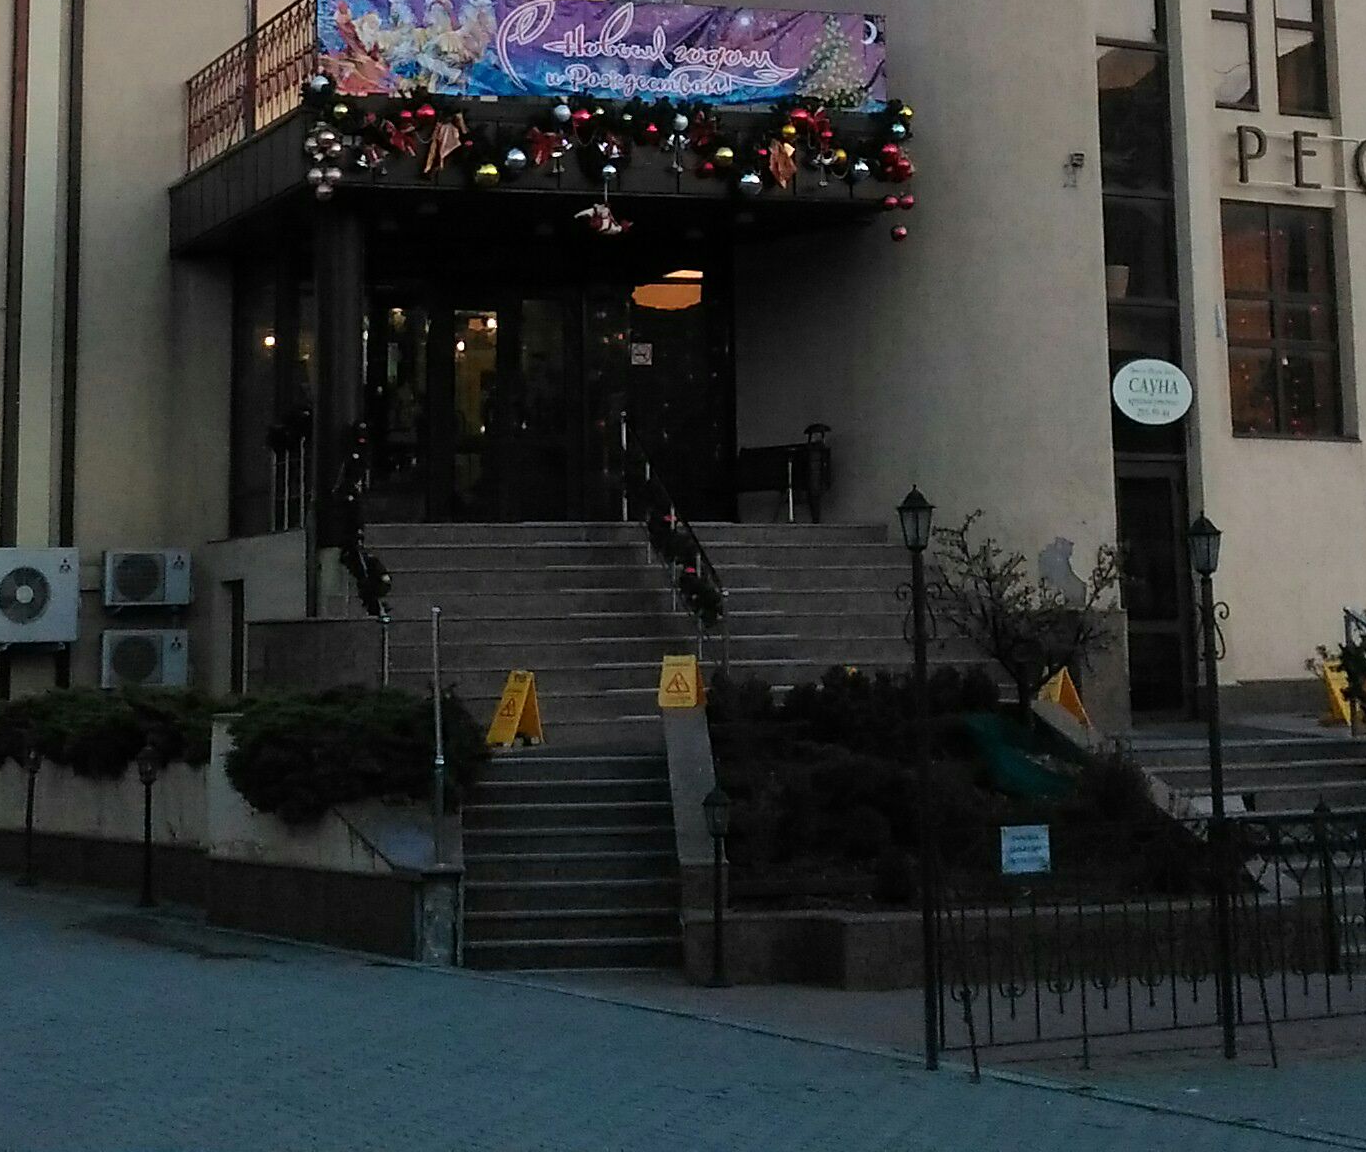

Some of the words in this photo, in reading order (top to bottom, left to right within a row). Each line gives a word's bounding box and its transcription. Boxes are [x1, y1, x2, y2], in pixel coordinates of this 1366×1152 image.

[497, 0, 555, 91] С
[543, 2, 673, 70] Новым
[671, 46, 800, 88] годом
[565, 64, 733, 98] Рождеством!
[1128, 377, 1179, 397] САУНА
